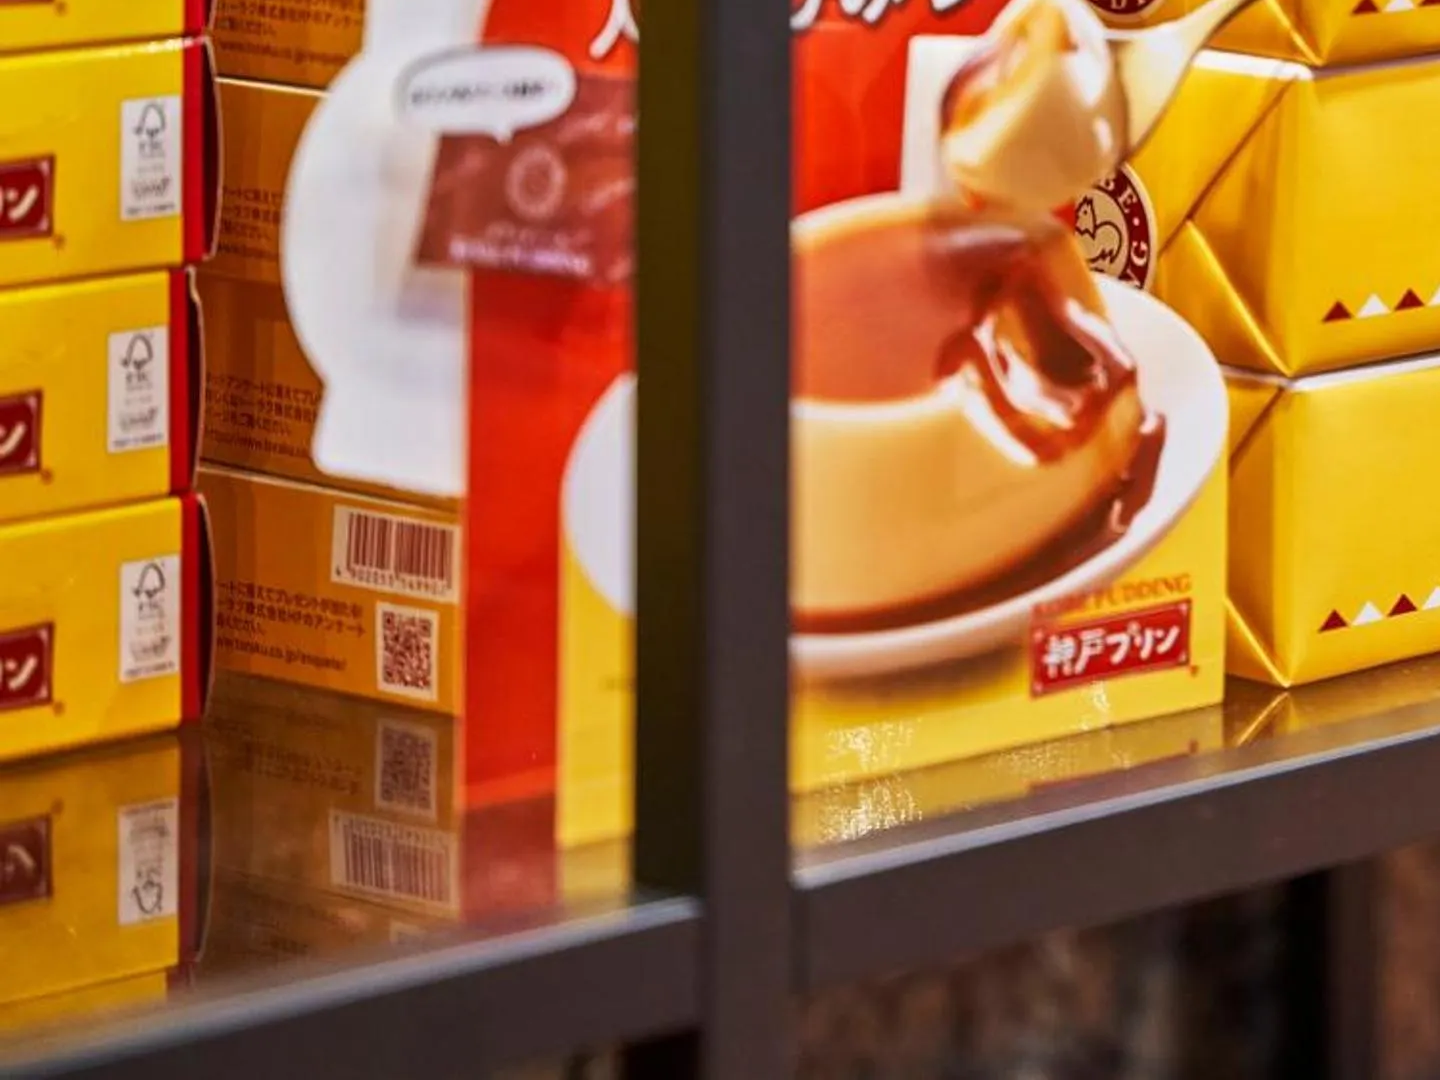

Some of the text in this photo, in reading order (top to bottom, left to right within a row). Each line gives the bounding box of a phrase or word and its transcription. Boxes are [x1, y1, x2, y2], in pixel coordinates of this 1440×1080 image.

[1041, 621, 1181, 680] 神戸プリン
